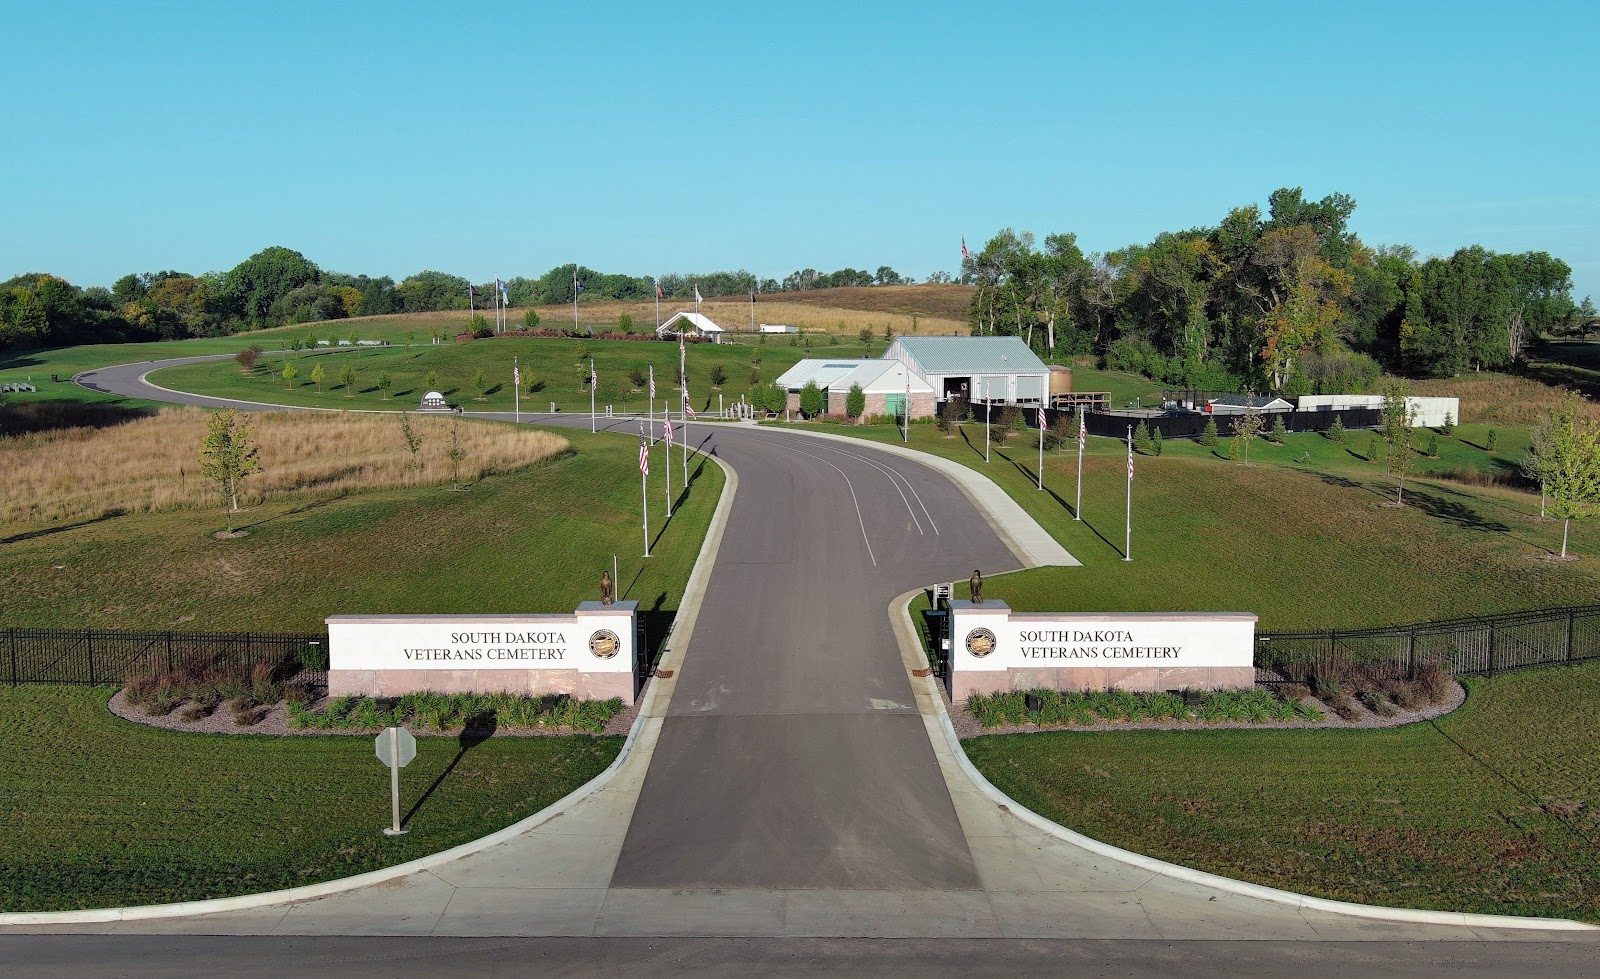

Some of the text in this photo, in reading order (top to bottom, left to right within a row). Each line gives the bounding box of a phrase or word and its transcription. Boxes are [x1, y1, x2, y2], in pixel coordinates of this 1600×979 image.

[451, 632, 567, 644] SOUTH DAKOTA
[1019, 630, 1134, 643] SOUTH DAKOTA
[403, 648, 567, 660] VETERANS CEMETERY
[1020, 646, 1182, 659] VETERANS CEMETERY
